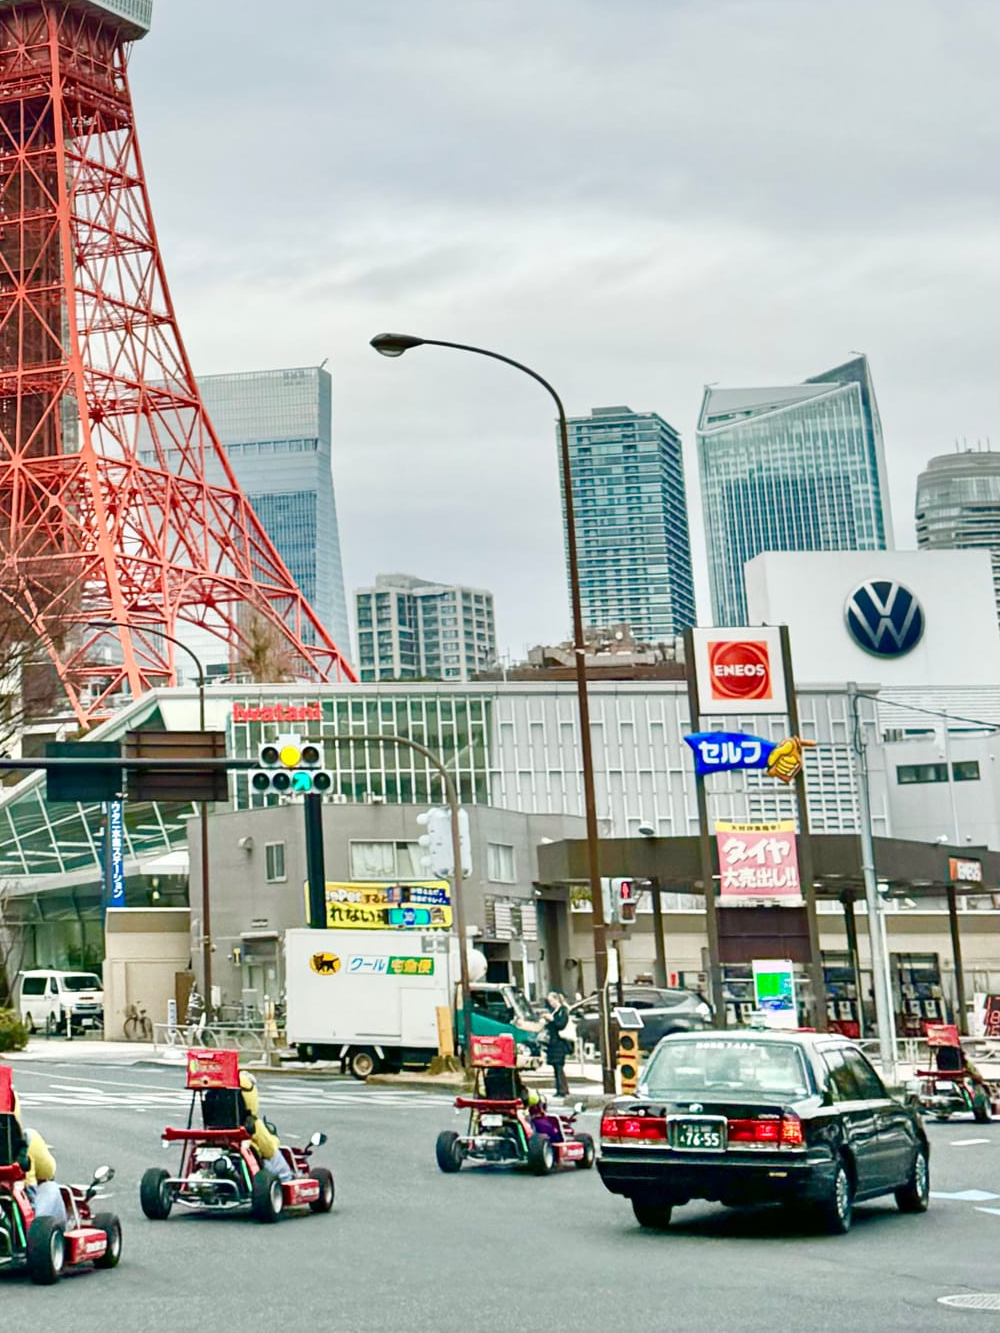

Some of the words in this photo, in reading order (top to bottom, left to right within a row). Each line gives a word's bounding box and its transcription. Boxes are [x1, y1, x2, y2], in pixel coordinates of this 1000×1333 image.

[714, 664, 766, 677] ENEOS
[232, 702, 321, 722] Iwatani
[698, 741, 762, 764] セルフ
[111, 801, 124, 899] ワタニ水素ステーション
[722, 837, 791, 865] タイヤ
[686, 1132, 719, 1146] 76-55
